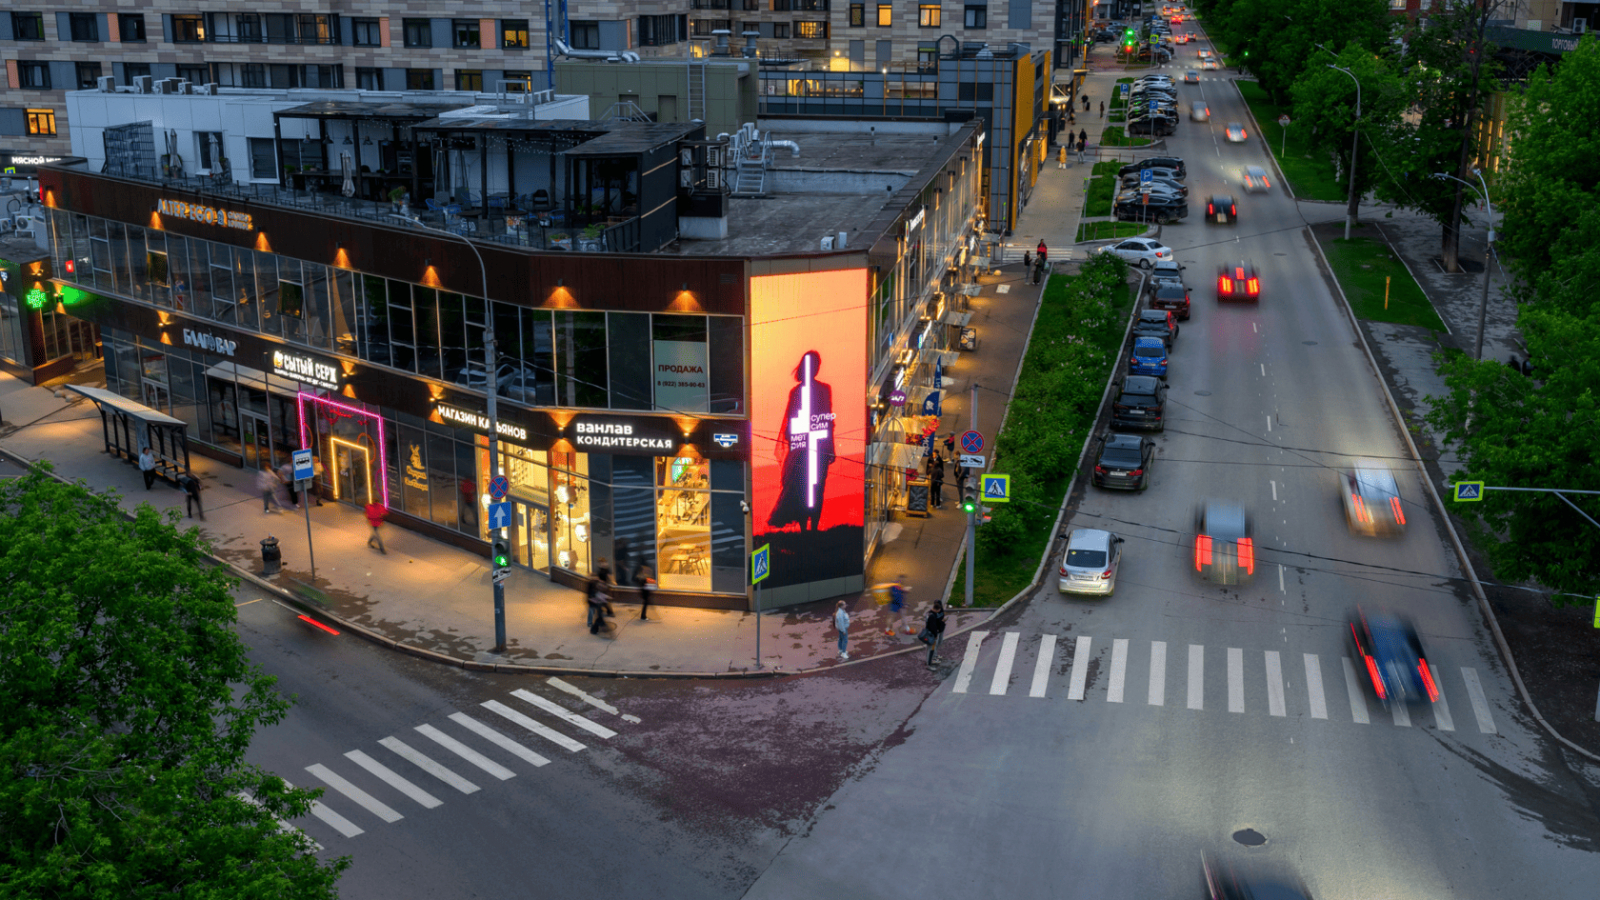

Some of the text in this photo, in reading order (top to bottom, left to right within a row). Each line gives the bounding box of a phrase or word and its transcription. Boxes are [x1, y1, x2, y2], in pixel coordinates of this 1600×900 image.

[11, 155, 45, 165] МЯСНОЙ
[157, 199, 214, 224] ALTER EGO
[284, 354, 314, 377] СЫТЫЙ
[658, 364, 703, 374] ПРОДАЖА
[437, 404, 527, 440] МАГАЗИН КАЬЯНОВ
[810, 412, 837, 423] супер
[576, 422, 633, 435] ванлав
[810, 422, 829, 430] сим
[577, 436, 673, 449] КОНДИТЕРСКАЯ
[790, 441, 807, 452] рия
